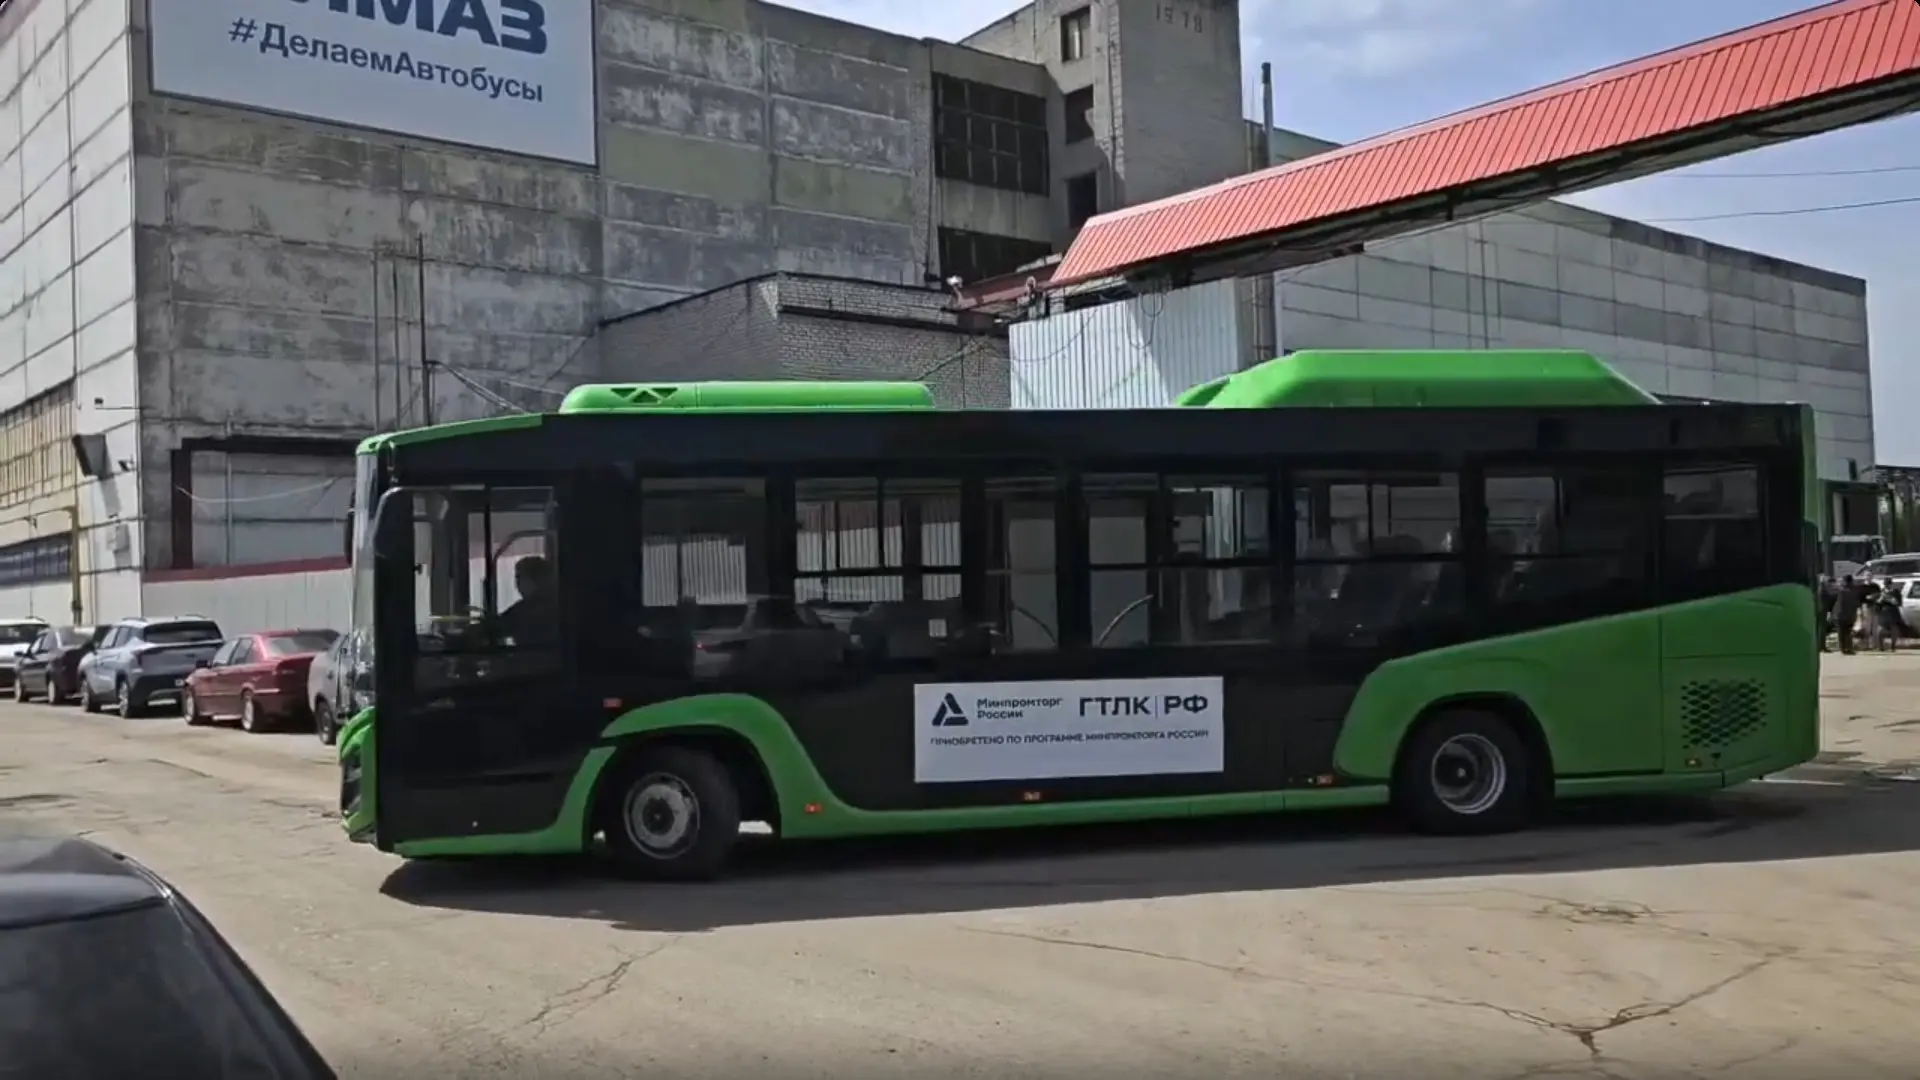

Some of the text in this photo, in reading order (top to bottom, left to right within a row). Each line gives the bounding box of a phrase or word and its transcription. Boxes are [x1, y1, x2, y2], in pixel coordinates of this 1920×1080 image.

[228, 17, 543, 102] #ДелаемАвтобусы
[977, 697, 1063, 709] Минпромторг
[1080, 694, 1208, 716] ГТЛК РФ
[977, 710, 1023, 719] России
[930, 736, 1004, 745] ПРИОБРЕТЕНО
[1006, 735, 1021, 744] ПО
[1024, 733, 1083, 743] ПРОГРАММЕ
[1167, 729, 1209, 739] РОССИИ
